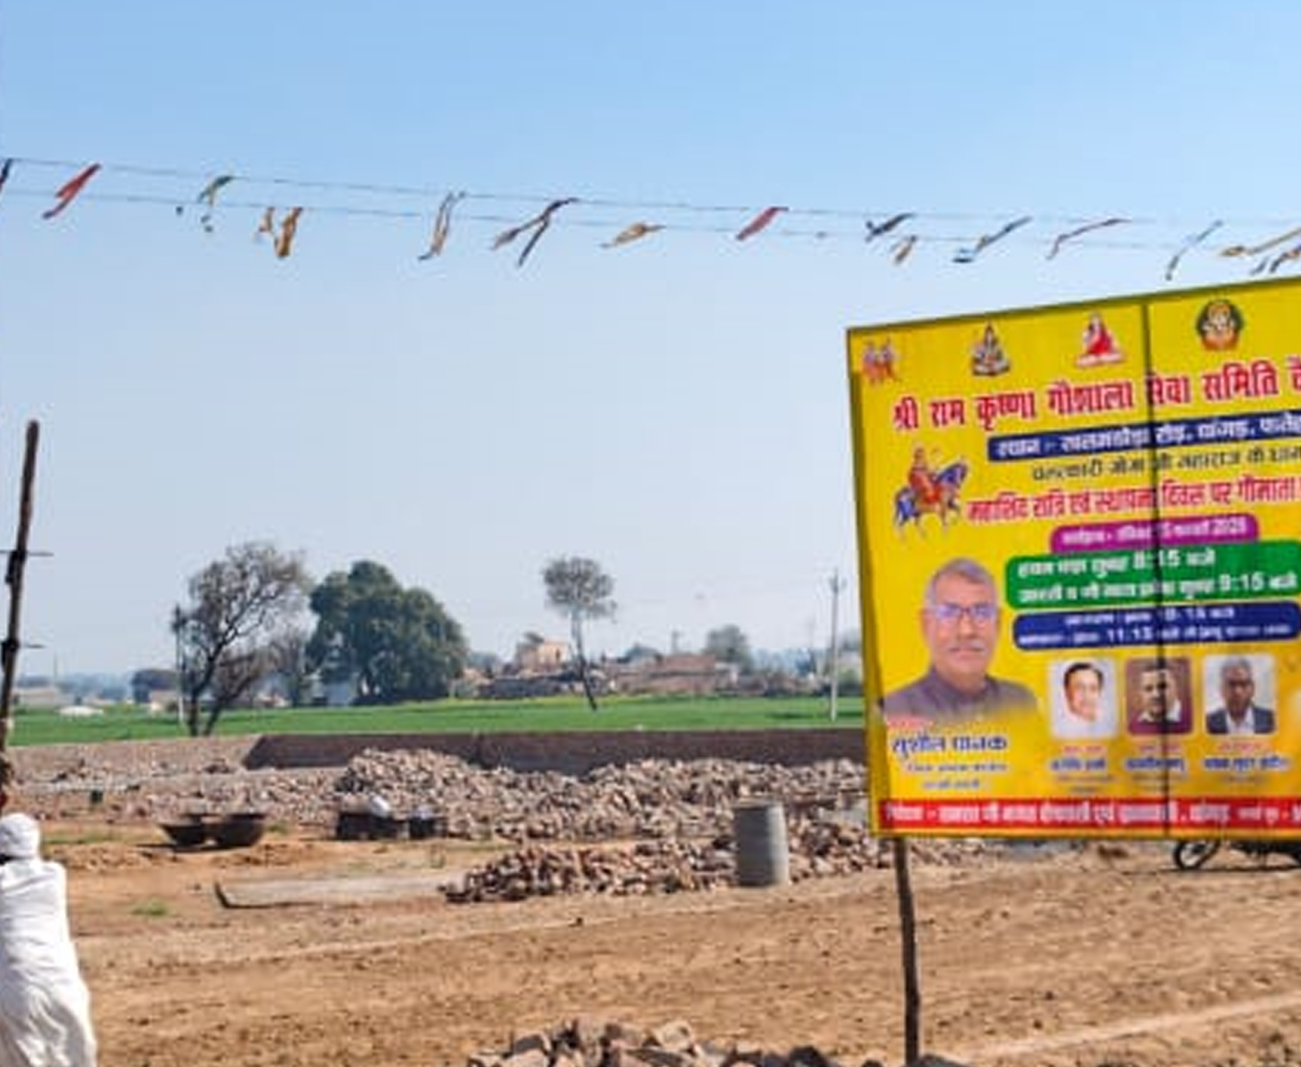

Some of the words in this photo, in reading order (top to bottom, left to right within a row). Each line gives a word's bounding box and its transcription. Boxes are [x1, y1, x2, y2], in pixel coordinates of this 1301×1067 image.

[893, 396, 919, 431] श्री
[929, 399, 965, 427] राम
[975, 392, 1037, 431] कृष्णा
[1047, 380, 1134, 415] गौशाला
[1147, 372, 1190, 406] सेवा
[1201, 360, 1279, 401] समिति
